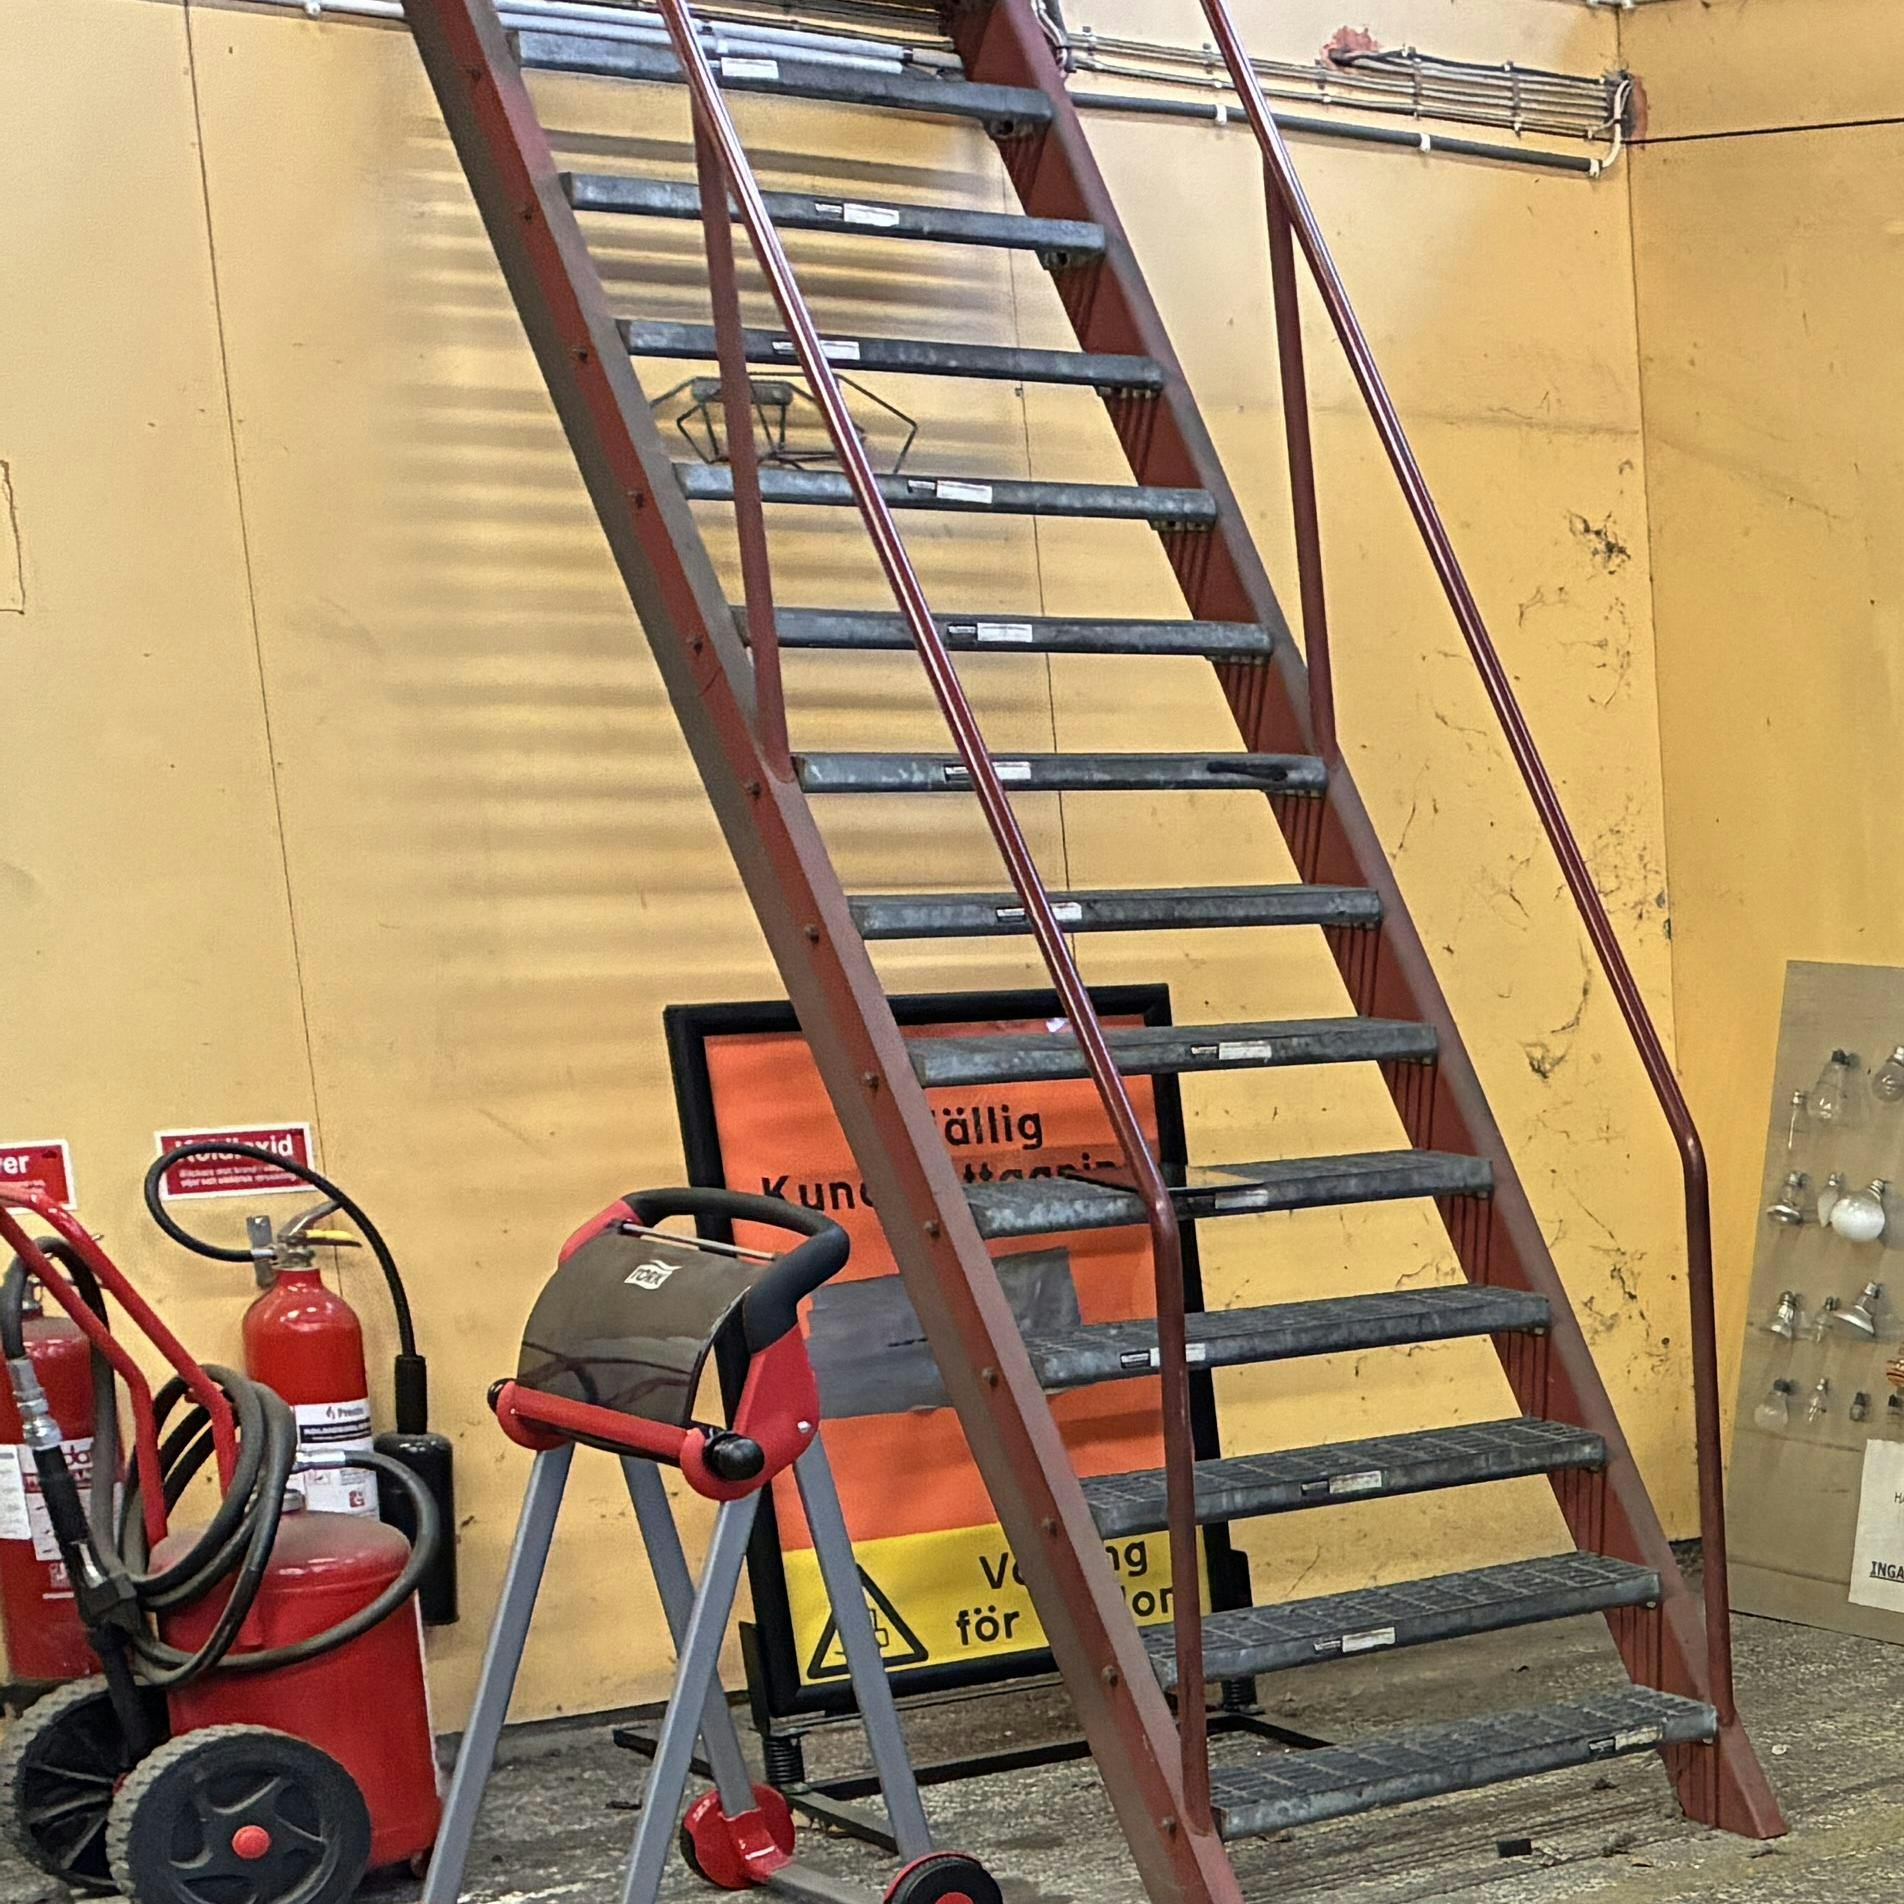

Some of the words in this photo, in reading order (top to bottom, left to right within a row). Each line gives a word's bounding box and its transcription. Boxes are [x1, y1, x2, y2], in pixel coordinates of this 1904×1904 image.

[930, 1104, 1043, 1150] ällig
[1870, 1560, 1904, 1581] INGA
[956, 1604, 1020, 1646] för
